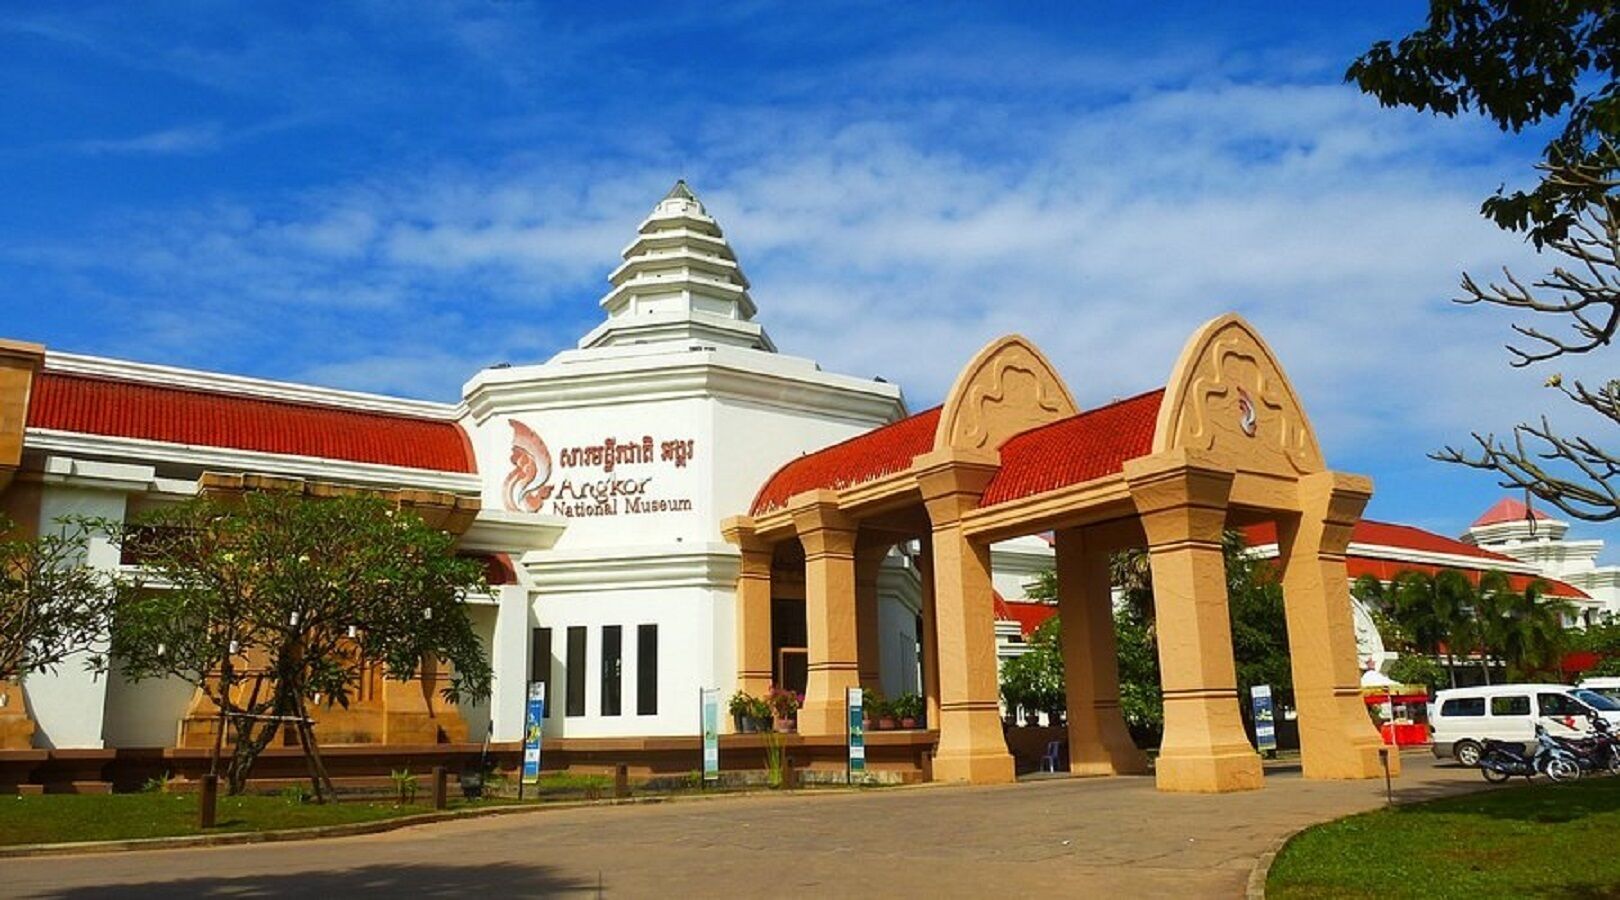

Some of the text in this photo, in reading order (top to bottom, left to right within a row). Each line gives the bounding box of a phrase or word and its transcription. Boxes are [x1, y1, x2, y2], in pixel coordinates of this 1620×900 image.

[555, 474, 652, 504] Angkor
[553, 497, 692, 518] National Museum
